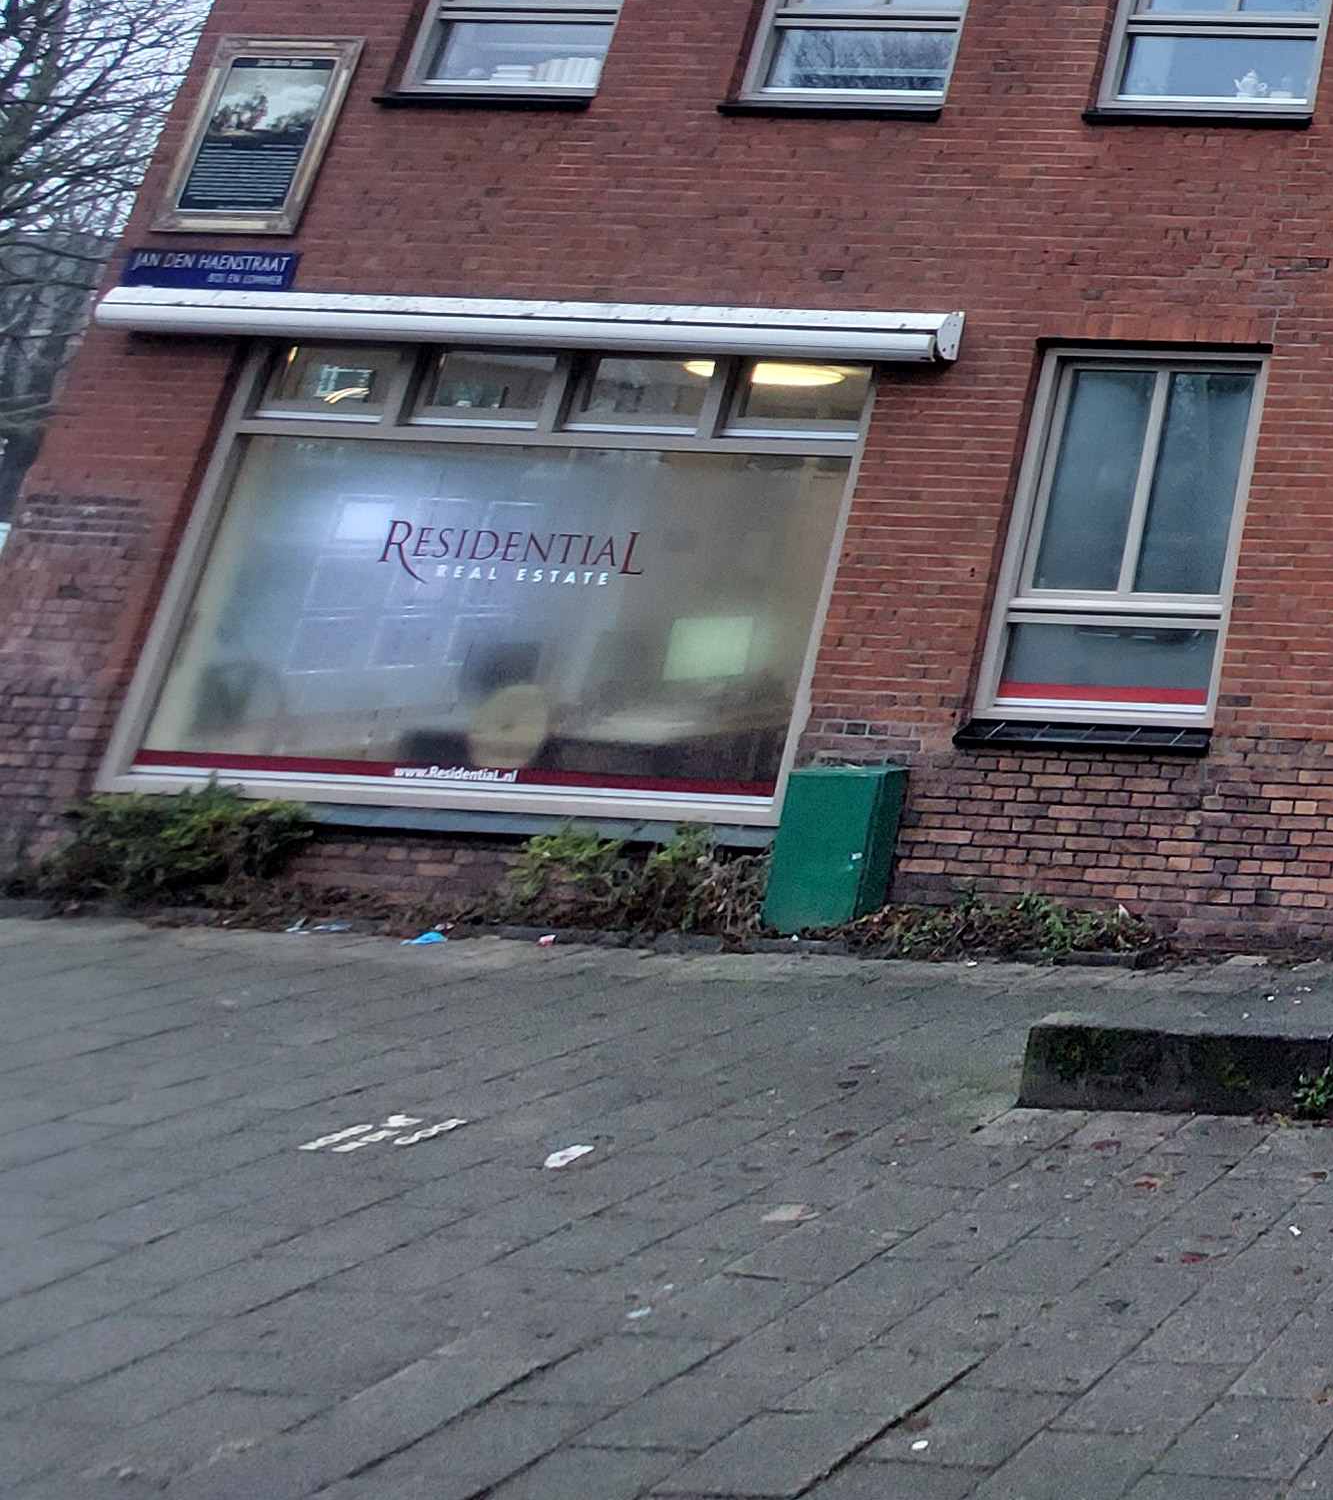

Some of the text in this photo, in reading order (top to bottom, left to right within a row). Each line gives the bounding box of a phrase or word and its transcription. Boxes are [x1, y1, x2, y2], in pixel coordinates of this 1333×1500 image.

[132, 252, 291, 273] JAN DEN HAENSTRAAT
[377, 520, 645, 584] RESIDENTIAL
[436, 565, 609, 585] REAL ESTATE
